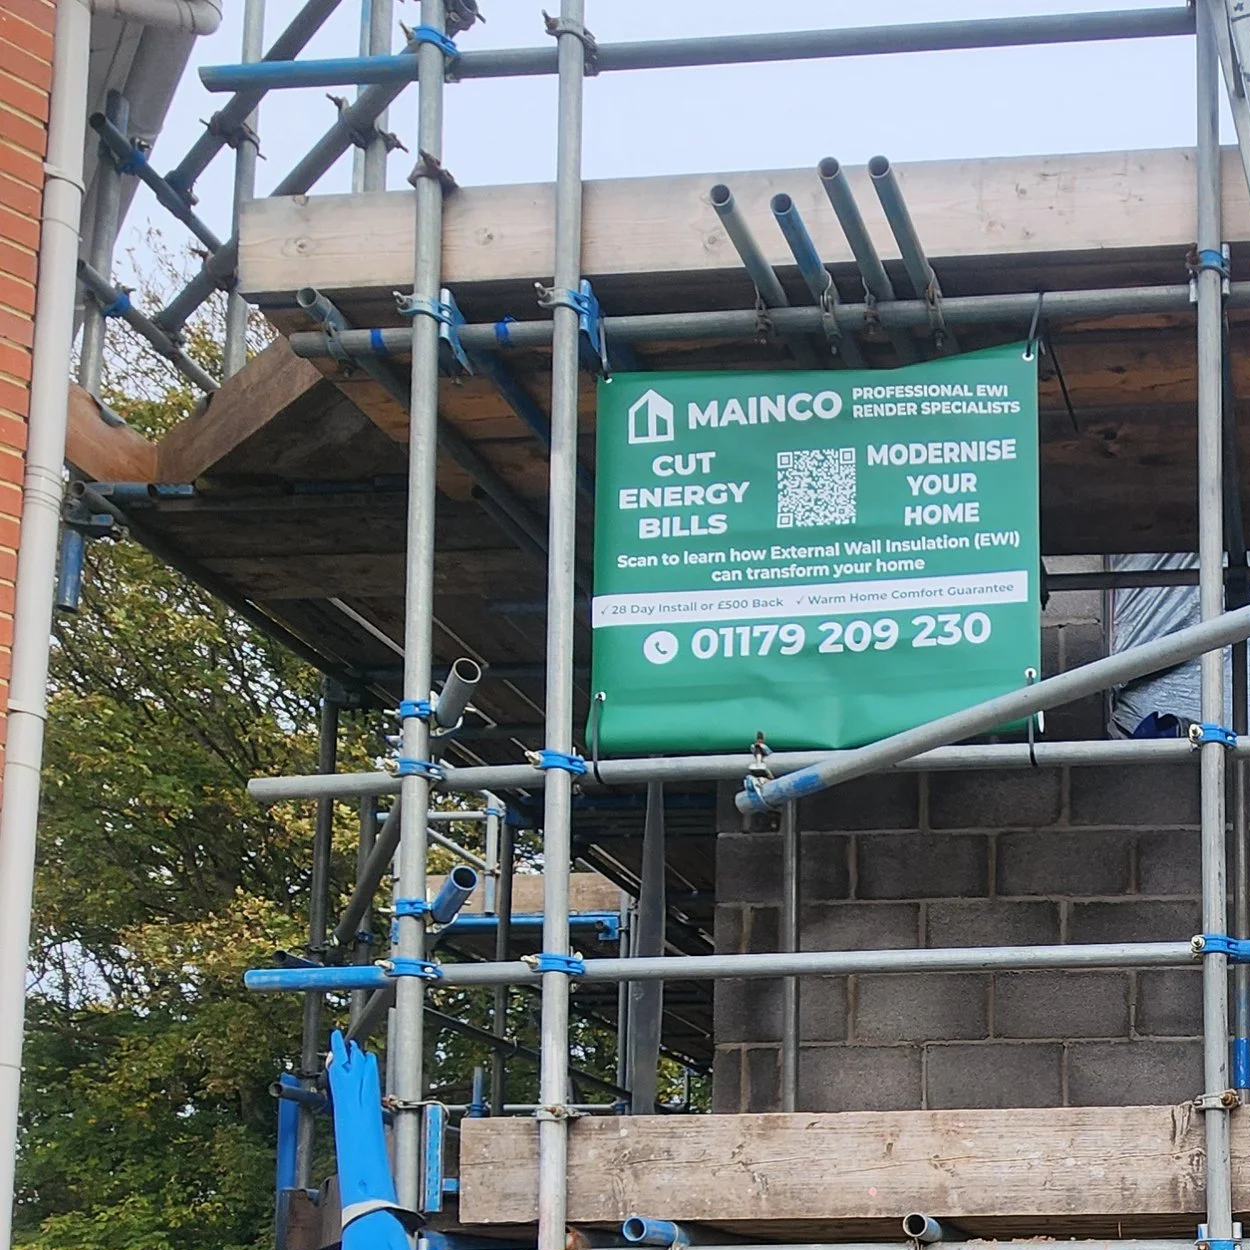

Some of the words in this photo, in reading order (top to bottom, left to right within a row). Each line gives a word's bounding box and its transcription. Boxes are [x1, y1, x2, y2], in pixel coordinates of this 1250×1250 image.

[852, 384, 973, 401] PROFESSIONAL
[976, 384, 1008, 398] EWI
[688, 391, 842, 430] MAINCO
[852, 403, 918, 418] RENDER
[921, 400, 1020, 416] SPECIALISTS
[652, 451, 716, 477] CUT
[867, 438, 1017, 466] MODERNISE
[619, 481, 750, 509] ENERGY
[906, 473, 977, 496] YOUR
[639, 514, 728, 539] BILLS
[904, 502, 980, 526] HOME
[617, 553, 658, 569] Scan
[662, 552, 680, 566] to
[684, 549, 726, 566] learn
[730, 546, 766, 562] how
[770, 541, 840, 560] External
[844, 539, 883, 556] Wall
[886, 534, 970, 554] Insulation
[974, 531, 1020, 549] (EWI)
[711, 568, 742, 582] can
[746, 563, 830, 581] transform
[833, 560, 872, 578] your
[876, 557, 925, 573] home
[808, 594, 845, 605] Warm
[850, 590, 887, 602] Home
[891, 585, 944, 599] Comfort
[948, 583, 1014, 596] Guarantee
[612, 605, 627, 614] 28
[630, 603, 655, 617] Day
[659, 601, 698, 613] Install
[701, 602, 713, 611] or
[717, 599, 748, 610] £500
[753, 597, 783, 608] Back
[691, 623, 805, 659] 01179
[818, 618, 898, 654] 209
[911, 612, 991, 648] 230
